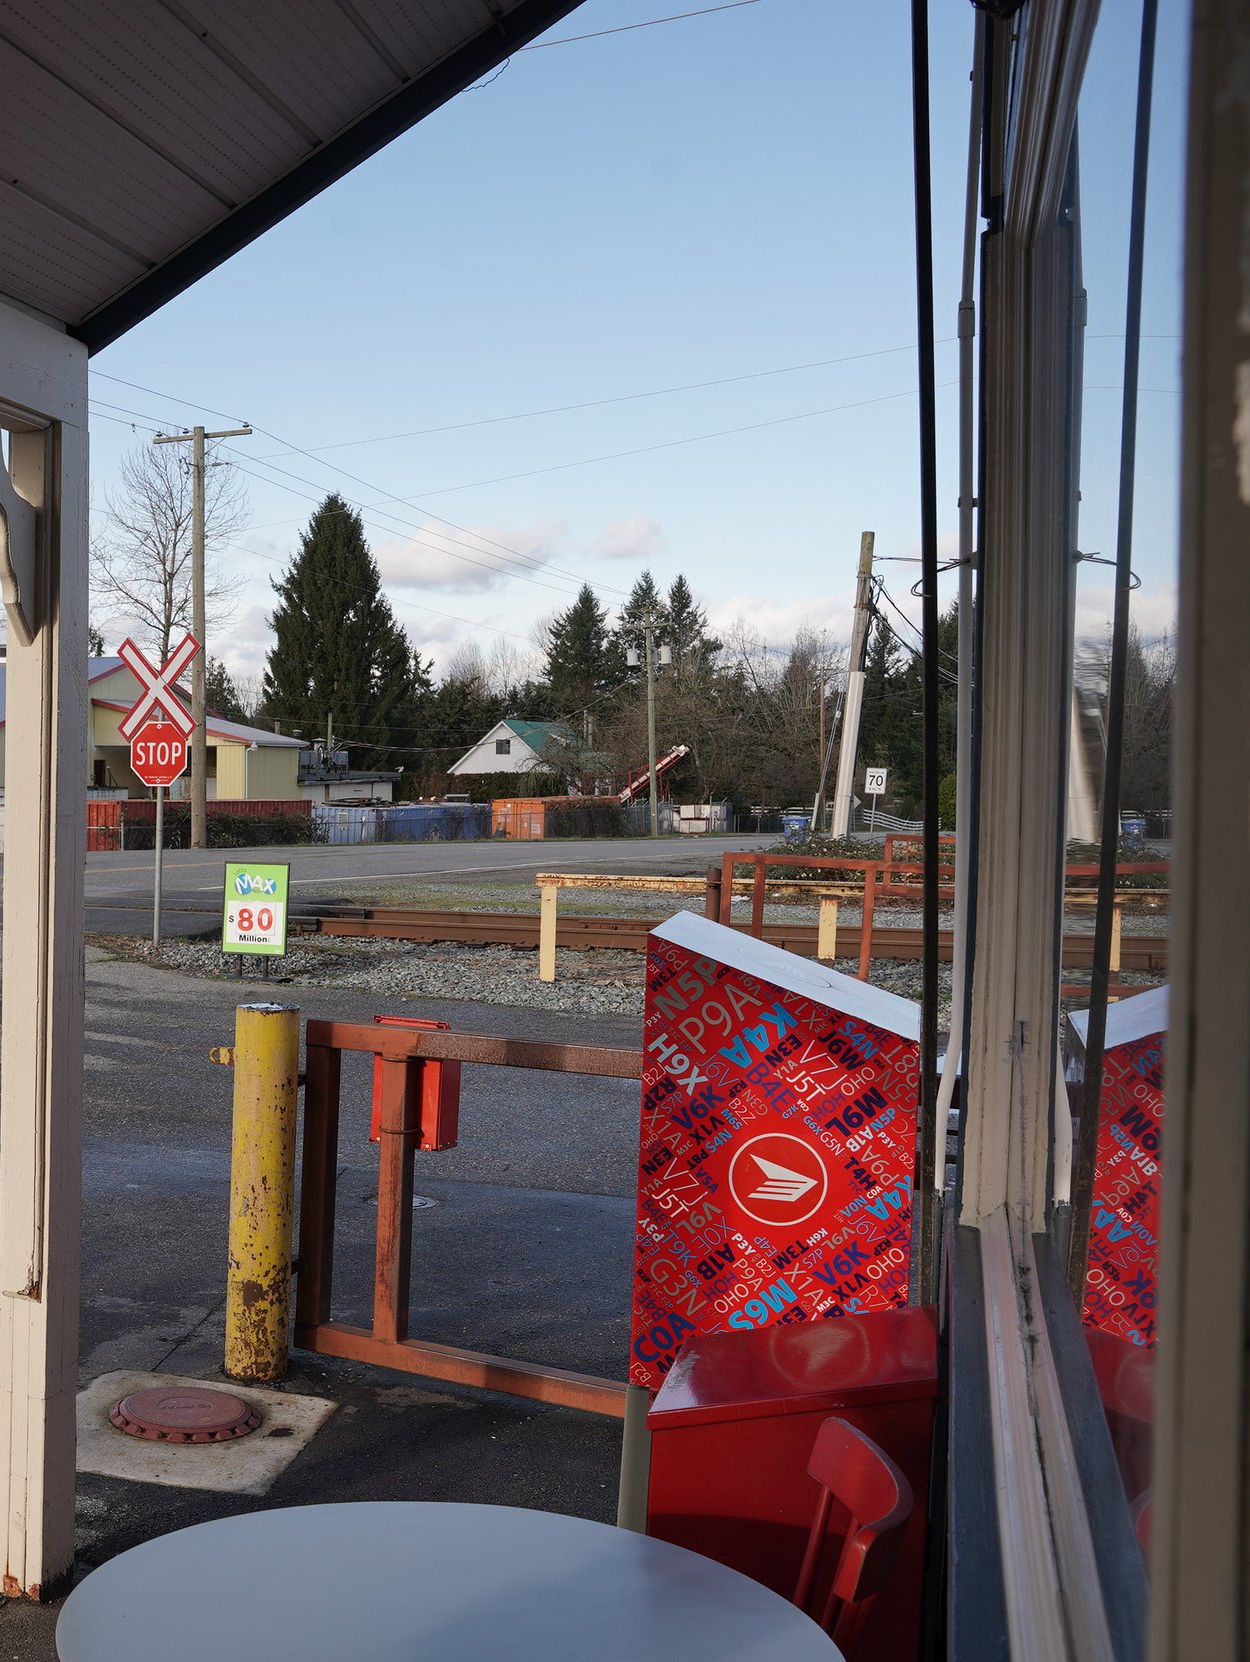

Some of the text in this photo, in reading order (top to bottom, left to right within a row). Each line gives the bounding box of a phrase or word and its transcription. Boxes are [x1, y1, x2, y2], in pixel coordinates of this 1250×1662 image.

[136, 742, 182, 766] STOP
[869, 774, 884, 786] 70
[235, 874, 275, 895] MAX
[228, 908, 273, 932] $ 80
[653, 956, 718, 1020] N5P
[646, 1012, 662, 1027] P3Y
[678, 984, 762, 1054] P9A
[718, 1002, 798, 1070] K4A
[818, 1030, 865, 1070] J6W
[838, 1020, 880, 1060] S4N
[648, 1032, 709, 1096] H9X
[764, 1034, 803, 1068] E3N
[800, 1040, 848, 1090] V7J
[642, 1062, 666, 1086] B2J
[696, 1054, 739, 1086] J6V
[773, 1060, 798, 1080] Y1A
[644, 1076, 678, 1110] R2P
[728, 1080, 748, 1098] R2P
[746, 1062, 796, 1112] B4E
[786, 1070, 826, 1102] J5T
[661, 1091, 682, 1114] S7P
[670, 1084, 726, 1129] V6K
[728, 1098, 756, 1126] B2Z
[742, 1089, 768, 1116] G3N
[782, 1104, 799, 1119] G7K
[825, 1086, 888, 1137] M9L
[644, 1107, 682, 1150] X1A
[688, 1116, 726, 1146] V1X
[721, 1108, 743, 1130] M6S
[804, 1116, 823, 1136] G6X
[870, 1108, 896, 1132] N5P
[676, 1140, 694, 1156] M3C
[706, 1128, 734, 1154] S4N
[820, 1132, 845, 1156] G5N
[846, 1125, 874, 1152] A1B
[878, 1131, 896, 1148] P3Y
[642, 1146, 674, 1176] E3N
[844, 1156, 877, 1190] T4H
[861, 1144, 900, 1186] P9A
[663, 1157, 708, 1206] V7J
[696, 1167, 718, 1194] V5A
[652, 1188, 690, 1218] J5T
[638, 1218, 665, 1242] P3Y
[676, 1202, 723, 1234] V9L
[848, 1214, 886, 1242] J6V
[662, 1228, 697, 1268] T9K
[731, 1232, 756, 1256] P3Y
[754, 1236, 778, 1258] E4P
[806, 1228, 828, 1246] K6H
[820, 1226, 856, 1250] V9L
[873, 1238, 892, 1256] R2P
[697, 1243, 736, 1280] A1B
[755, 1258, 776, 1278] B2J
[772, 1240, 810, 1270] T3M
[802, 1248, 824, 1268] S7P
[812, 1240, 871, 1286] V6K
[650, 1258, 708, 1316] G3N
[732, 1258, 764, 1292] P9A
[783, 1262, 824, 1306] X1A
[832, 1272, 870, 1302] V1X
[728, 1277, 798, 1330] M6S
[816, 1296, 836, 1312] M3C
[630, 1362, 652, 1383] B2J
